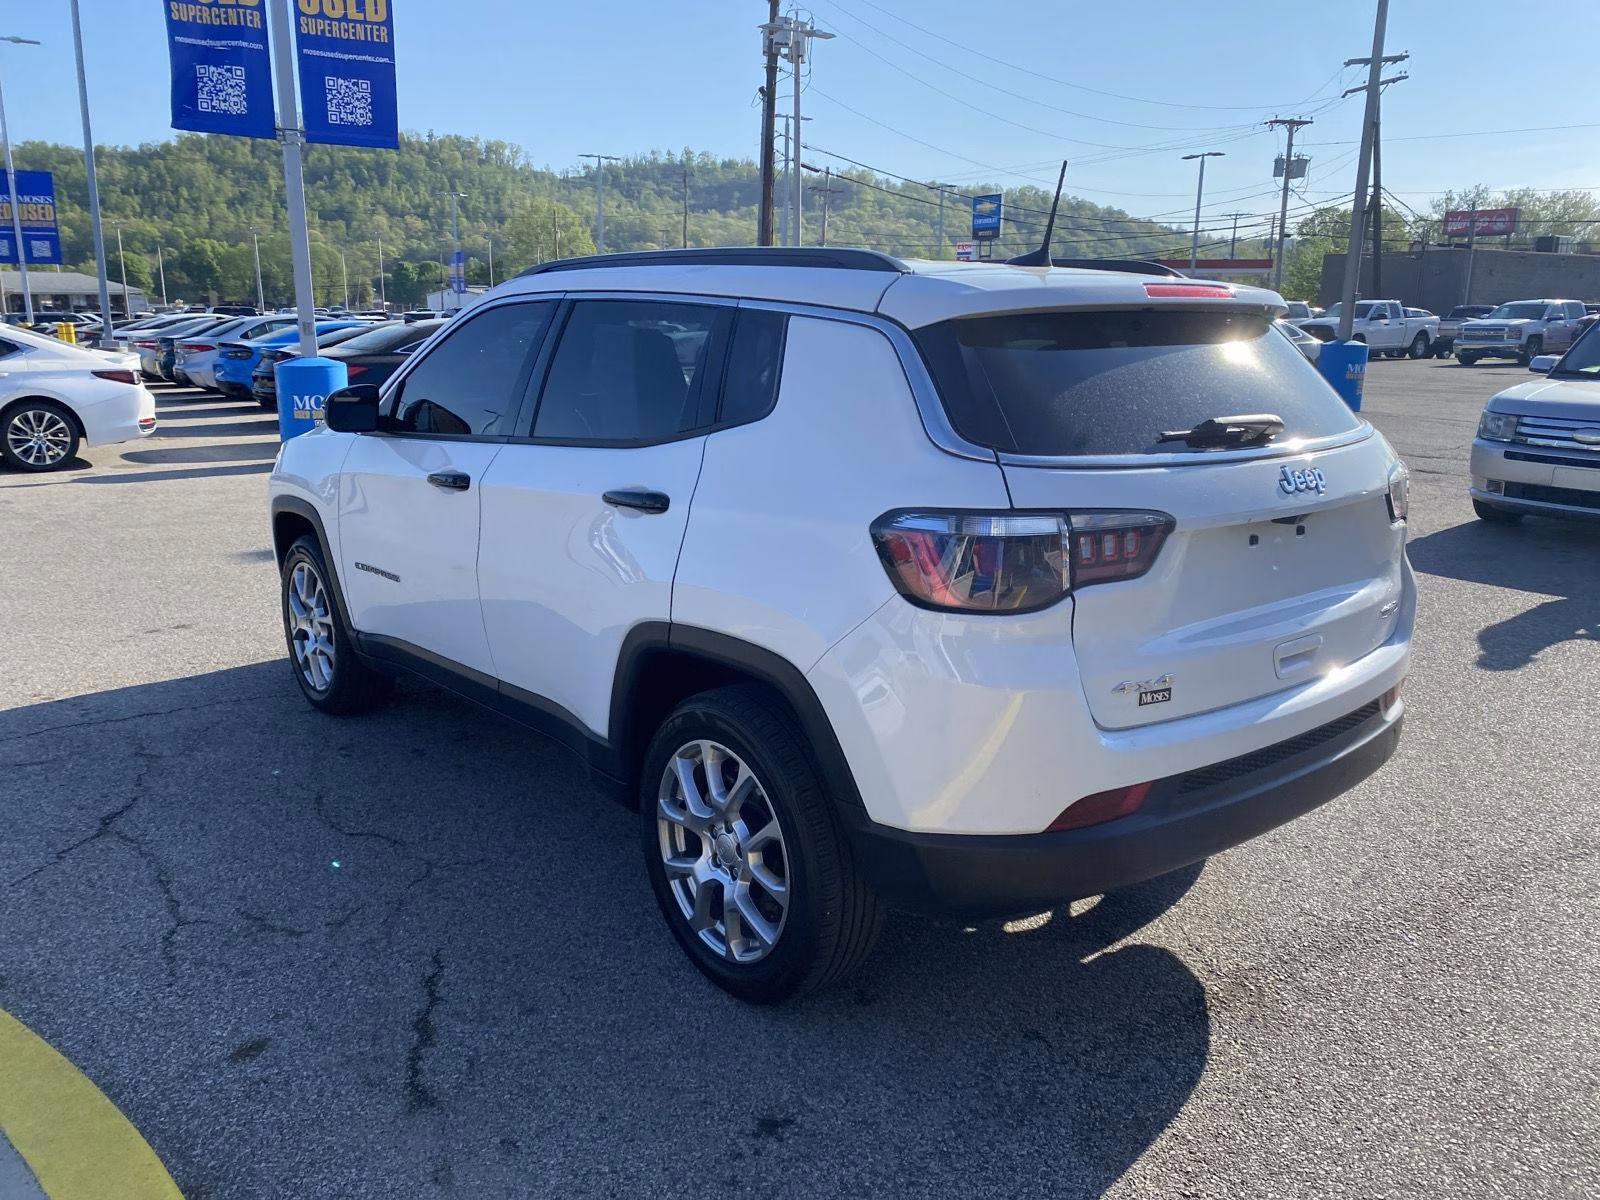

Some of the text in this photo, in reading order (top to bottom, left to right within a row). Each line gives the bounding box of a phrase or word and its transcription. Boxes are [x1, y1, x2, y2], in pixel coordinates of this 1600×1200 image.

[170, 1, 261, 29] SUPERCENTER
[300, 16, 388, 43] SUPERCENTER
[18, 204, 54, 221] USED
[293, 394, 325, 410] MO
[1279, 464, 1326, 496] Jeep
